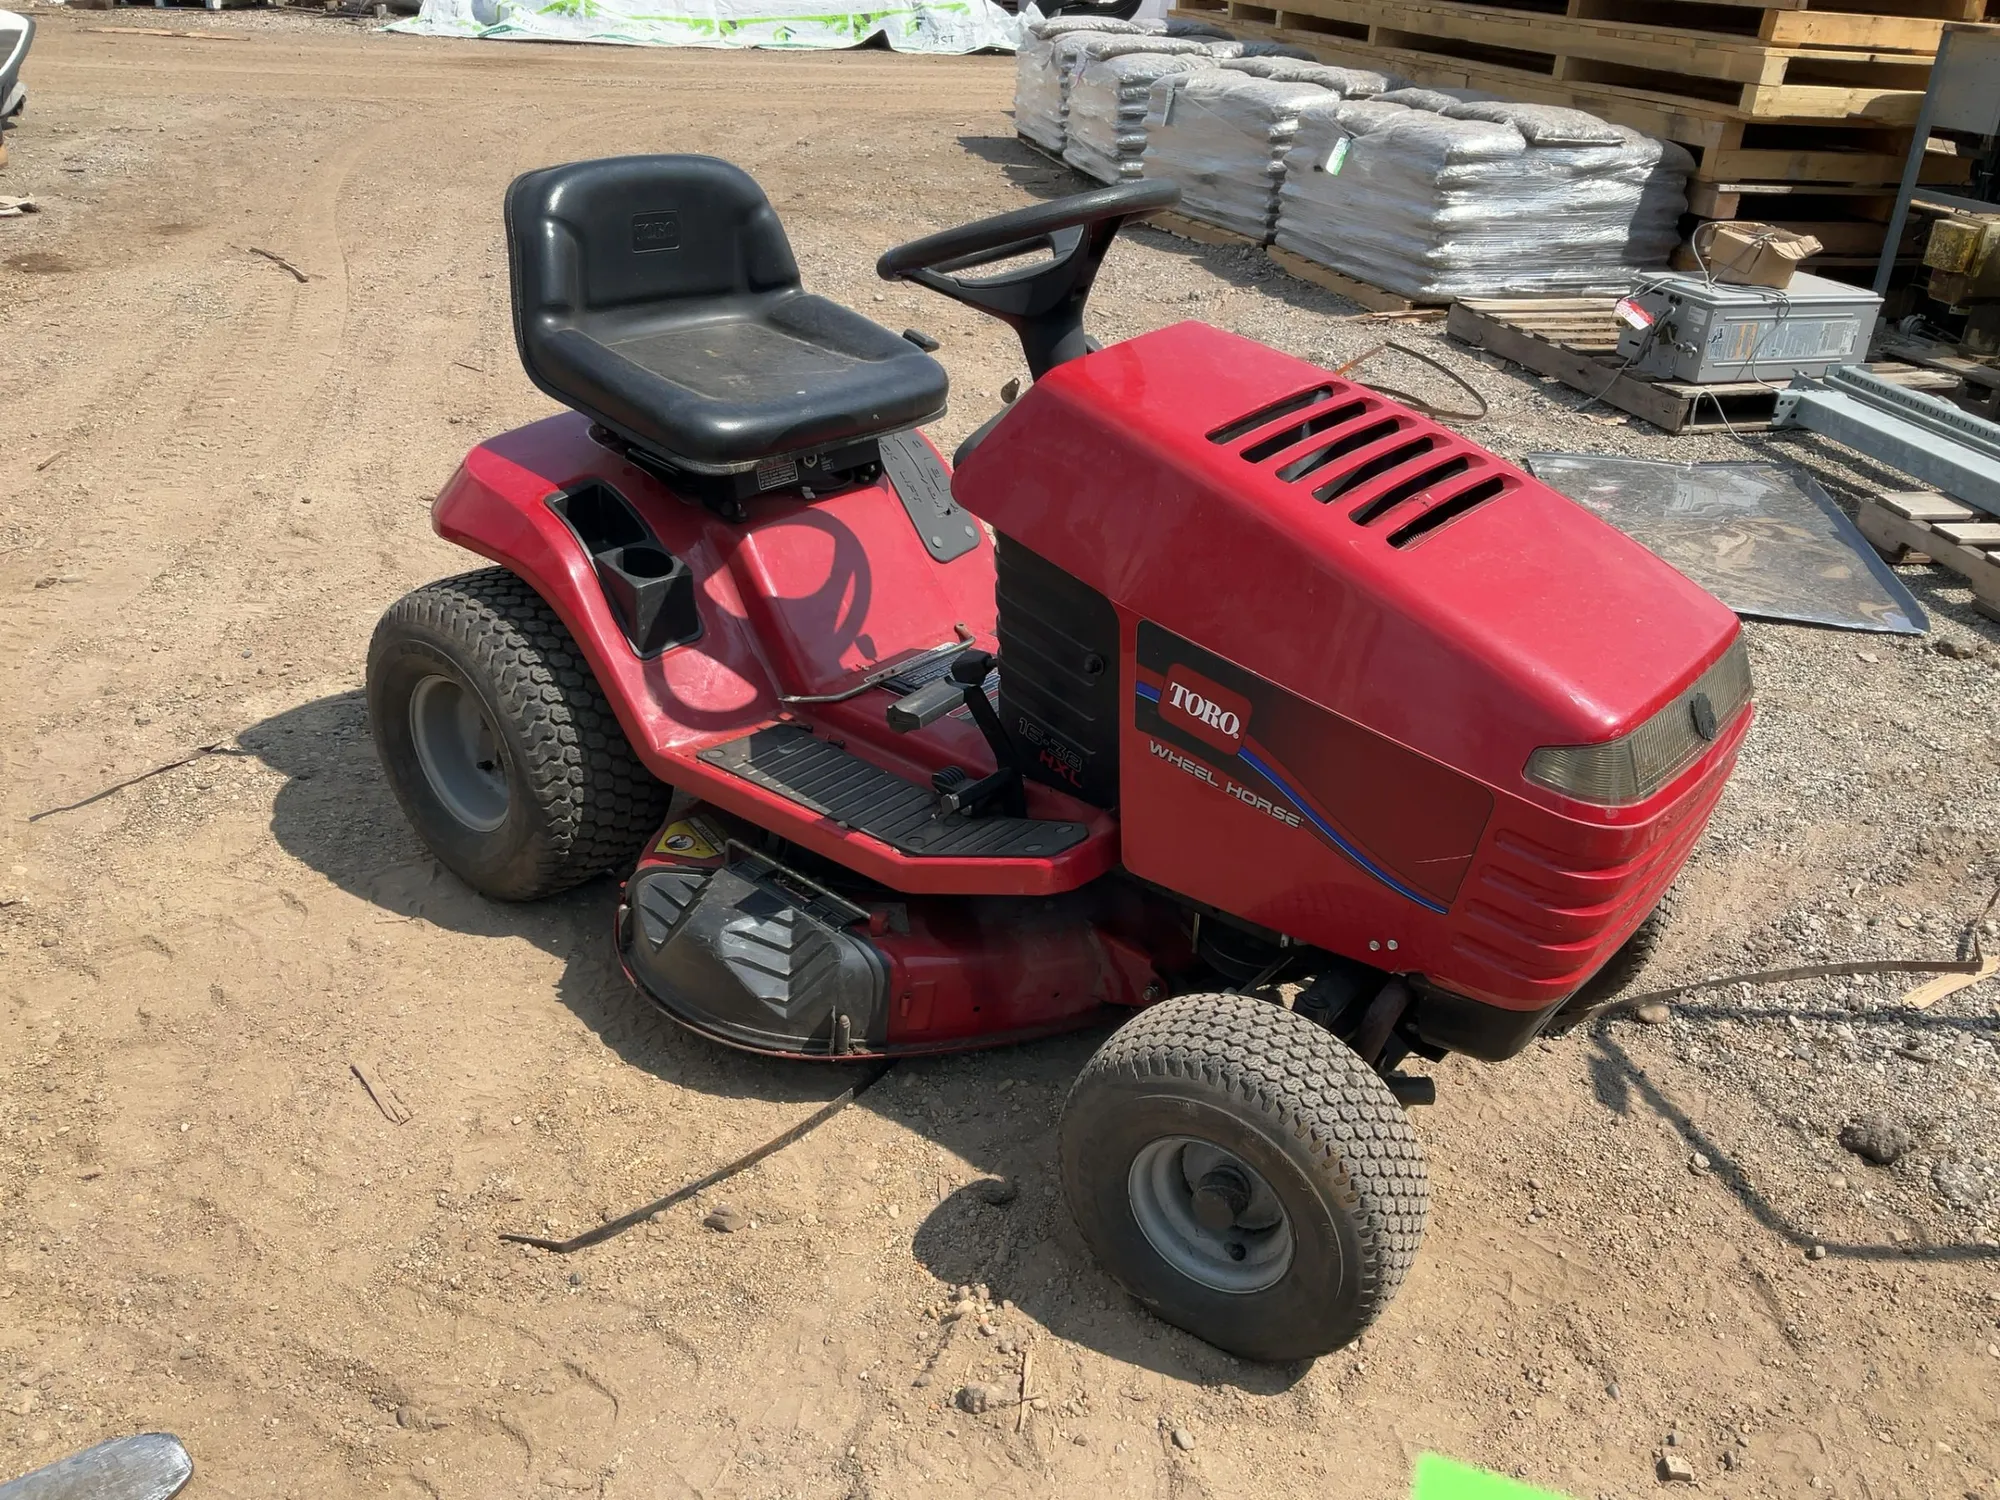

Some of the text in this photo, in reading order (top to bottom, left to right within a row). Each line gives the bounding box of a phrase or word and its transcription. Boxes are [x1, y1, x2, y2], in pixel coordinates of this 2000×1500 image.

[1169, 681, 1240, 739] TORO
[1039, 750, 1082, 789] HXL
[1149, 740, 1301, 828] WHEEL HORSE
